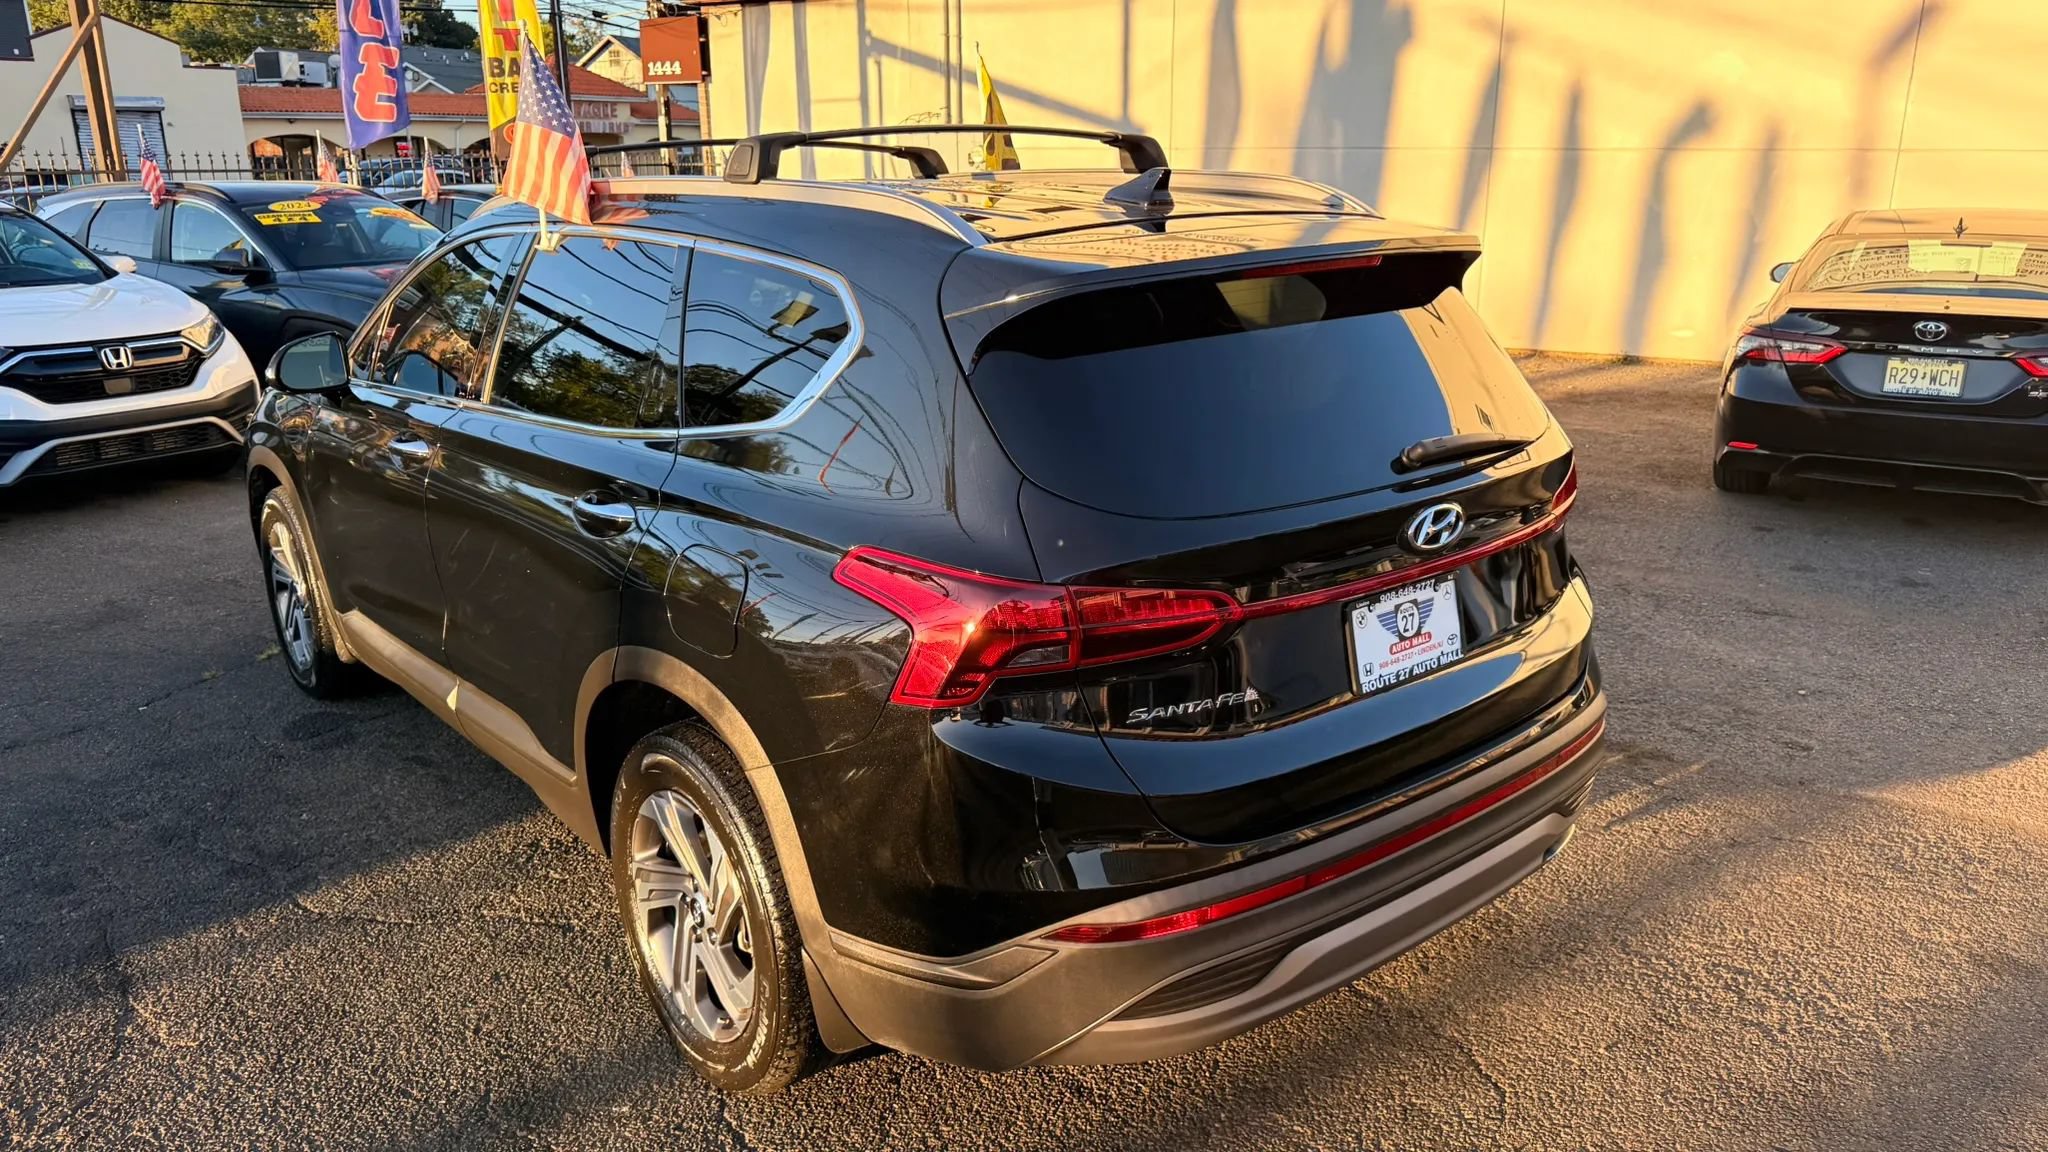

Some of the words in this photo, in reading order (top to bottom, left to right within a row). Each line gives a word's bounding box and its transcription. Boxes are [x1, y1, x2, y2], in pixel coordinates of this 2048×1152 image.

[489, 57, 520, 78] BA
[648, 61, 682, 76] 1444
[489, 81, 519, 93] CRE
[280, 202, 311, 210] 2024
[1888, 367, 1918, 384] R29
[1929, 369, 1960, 387] WCH
[1380, 579, 1435, 603] 908-648-2727
[1401, 613, 1415, 634] 27
[1392, 641, 1411, 653] AUTO
[1412, 633, 1430, 648] MALL
[1362, 674, 1397, 694] ROUTE
[1398, 667, 1410, 681] 27
[1413, 659, 1438, 676] AUTO
[1440, 648, 1464, 664] MALL
[1126, 699, 1213, 723] SANTA
[1216, 692, 1244, 709] FE
